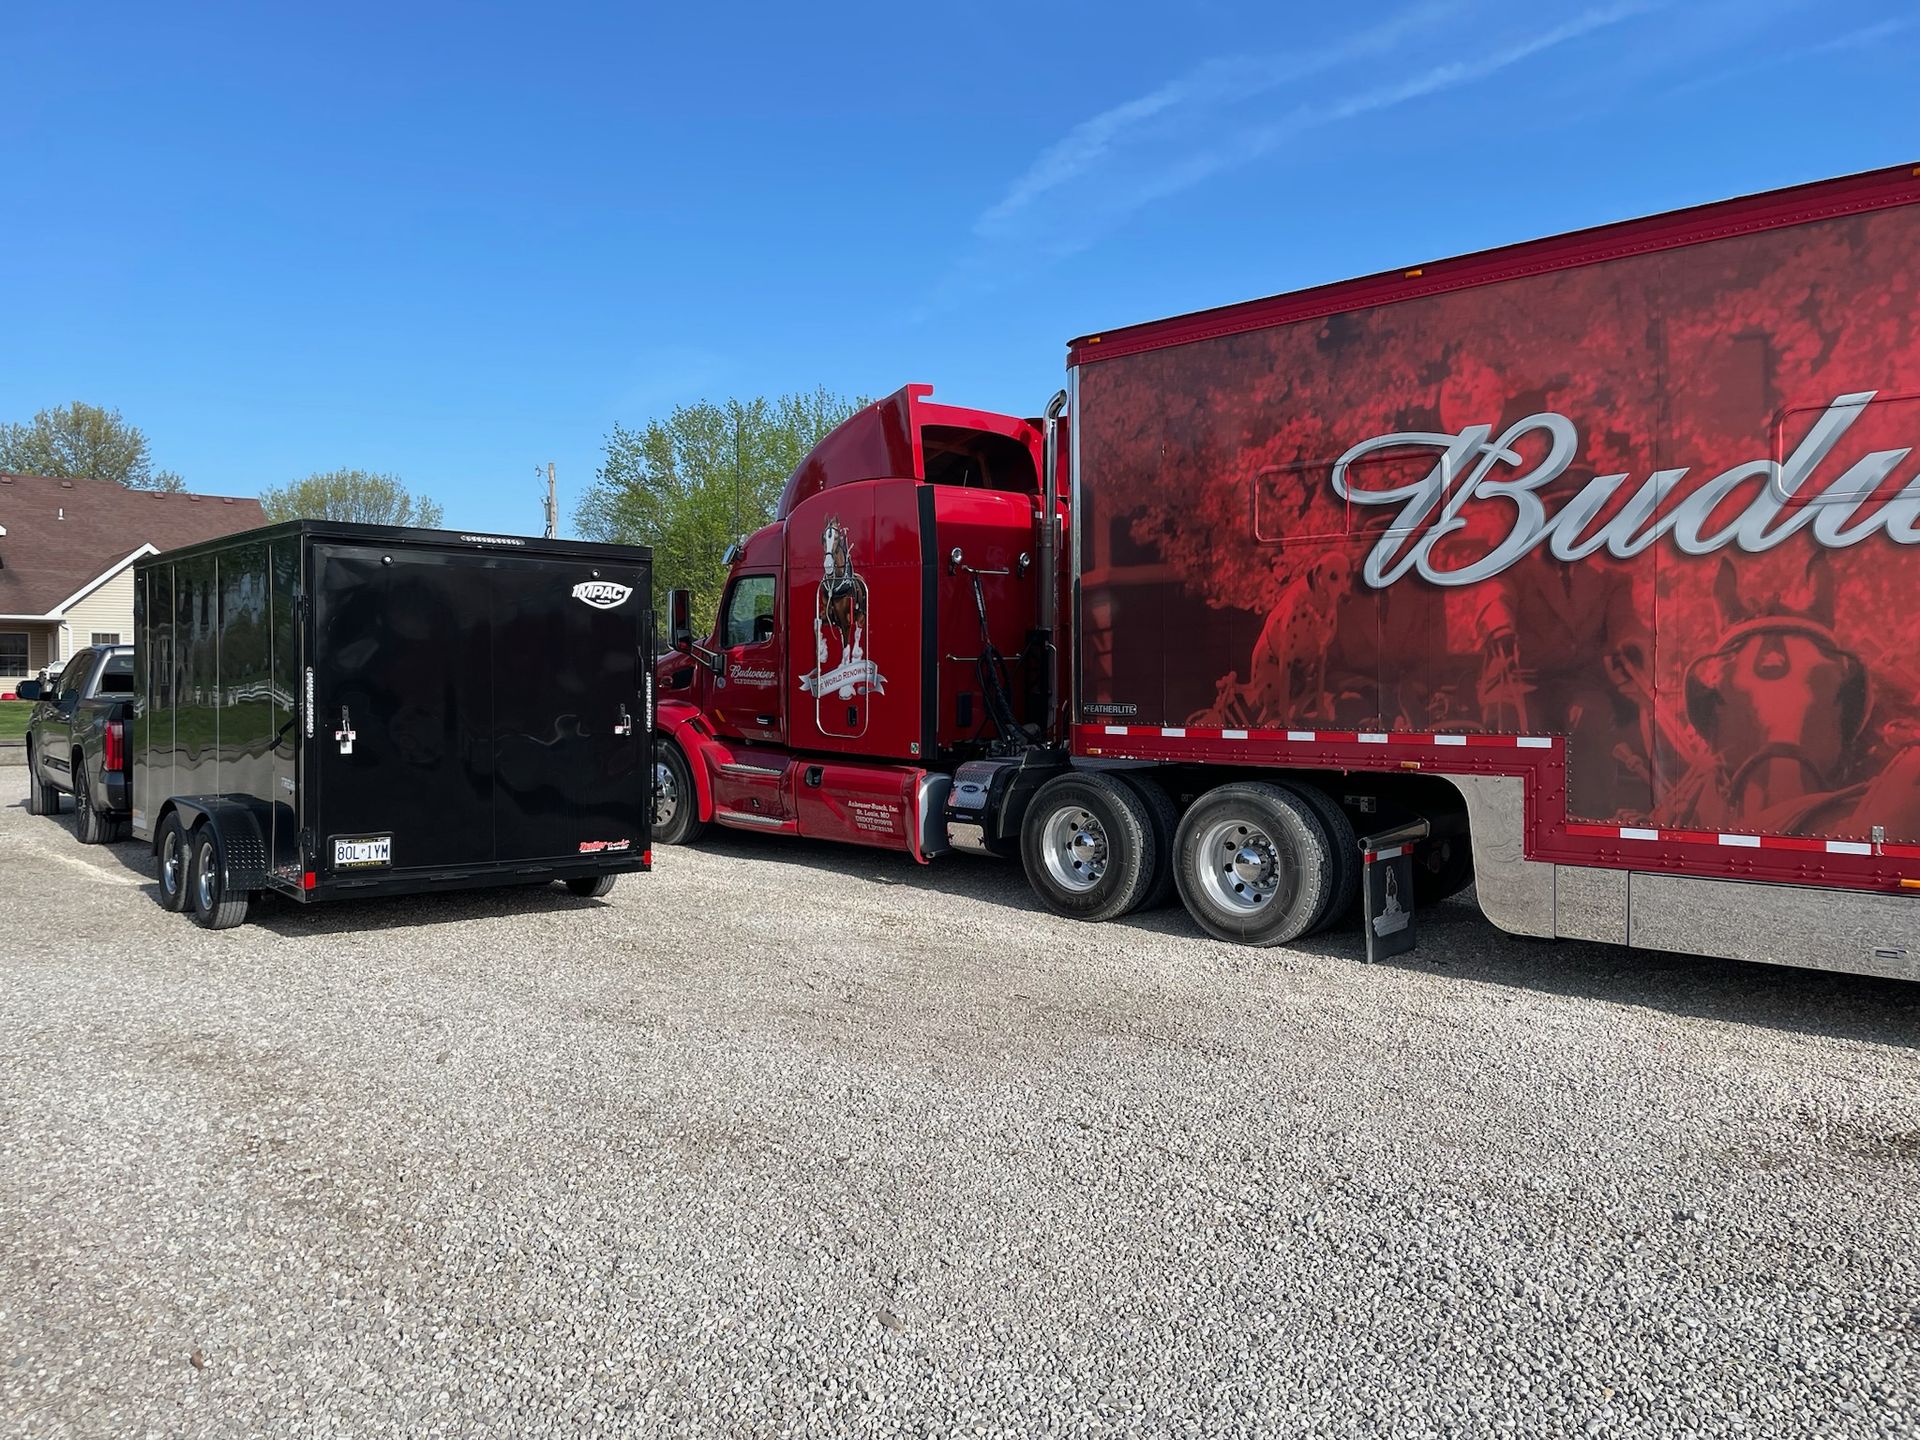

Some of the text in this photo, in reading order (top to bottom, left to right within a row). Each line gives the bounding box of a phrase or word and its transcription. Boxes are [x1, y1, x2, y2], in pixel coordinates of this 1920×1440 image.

[571, 584, 633, 600] IMPACT
[729, 664, 776, 679] Budweiser
[824, 675, 843, 688] WORLD
[1086, 704, 1134, 714] FEATHERLITE
[338, 846, 359, 860] 80L
